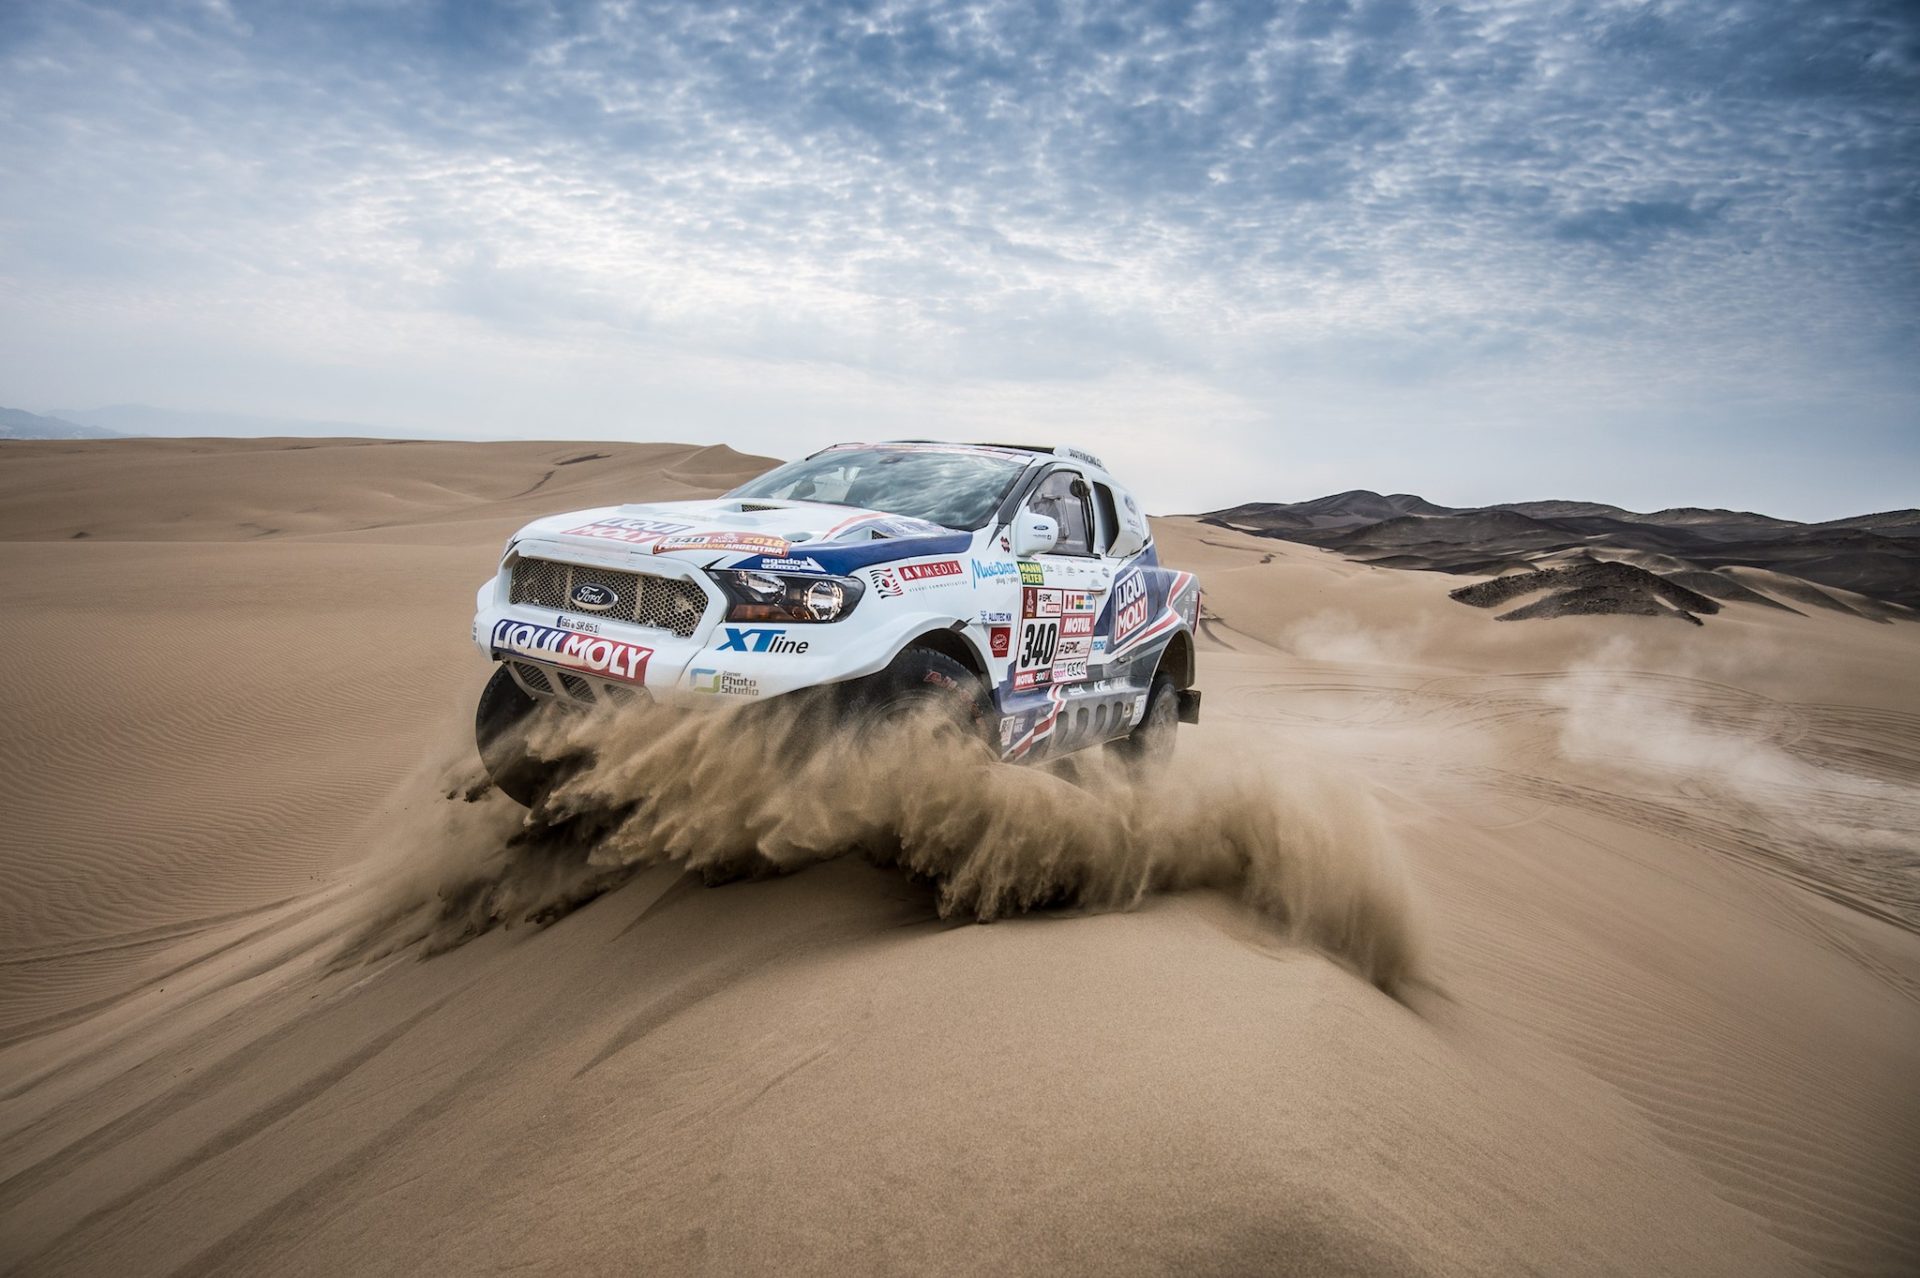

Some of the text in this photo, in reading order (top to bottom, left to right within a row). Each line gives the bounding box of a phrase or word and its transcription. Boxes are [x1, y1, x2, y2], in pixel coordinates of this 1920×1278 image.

[742, 537, 786, 547] 2018
[761, 557, 808, 567] agados
[1019, 563, 1041, 574] MANN
[1022, 572, 1044, 583] FILTER
[576, 585, 605, 604] Ford
[1118, 572, 1145, 611] LIQUI
[1117, 597, 1146, 638] MOLY
[1063, 617, 1091, 634] MOTUL
[494, 620, 567, 654] LIQUI
[562, 634, 652, 679] MOLY
[1021, 623, 1057, 668] 340
[721, 676, 757, 687] Photo
[1015, 673, 1034, 686] MOTUL
[721, 684, 760, 697] Studio
